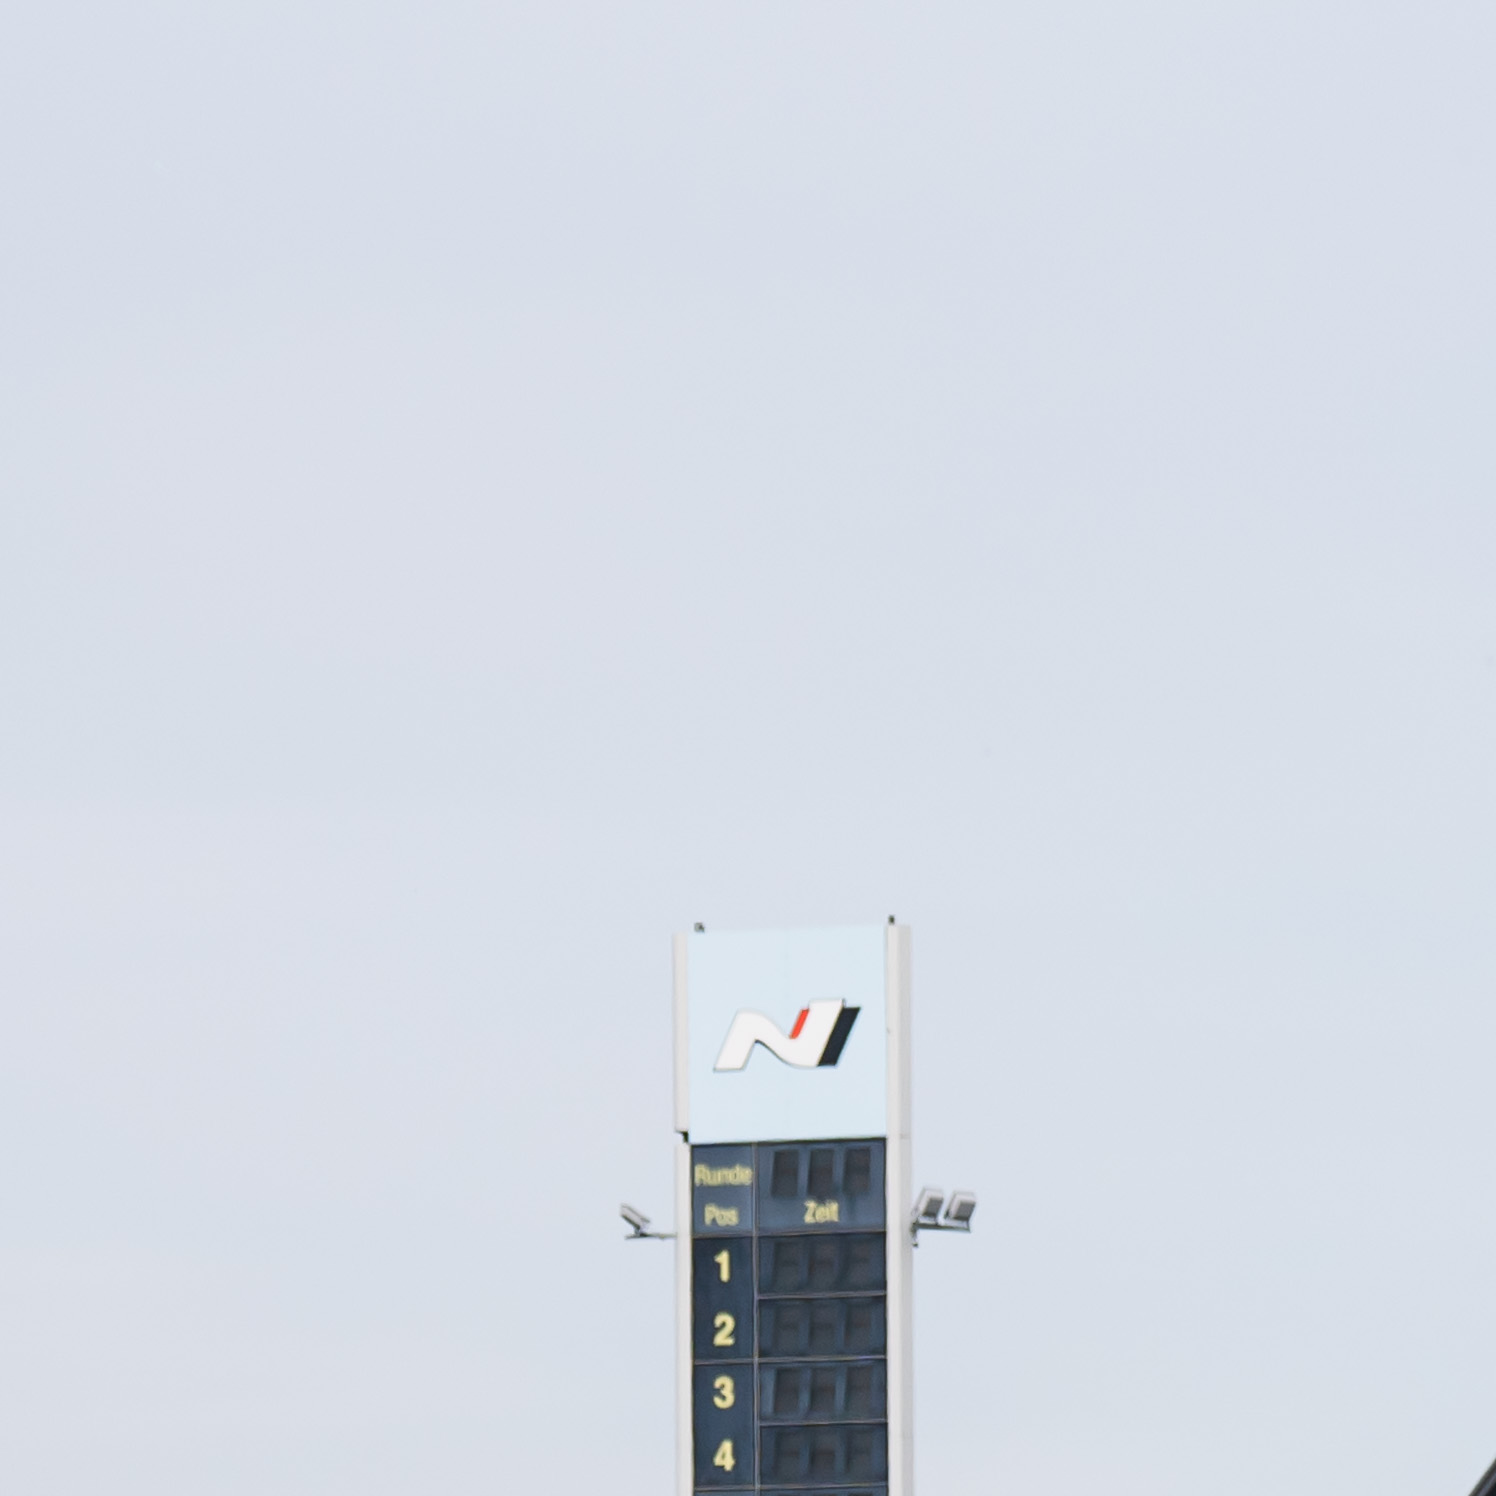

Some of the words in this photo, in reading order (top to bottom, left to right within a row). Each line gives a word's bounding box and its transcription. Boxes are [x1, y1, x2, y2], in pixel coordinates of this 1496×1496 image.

[694, 1164, 752, 1186] Runde
[704, 1204, 739, 1226] Pos
[804, 1199, 840, 1223] Zeit
[713, 1250, 730, 1283] 1
[713, 1312, 735, 1346] 2
[713, 1376, 735, 1409] 3
[713, 1439, 735, 1472] 4
